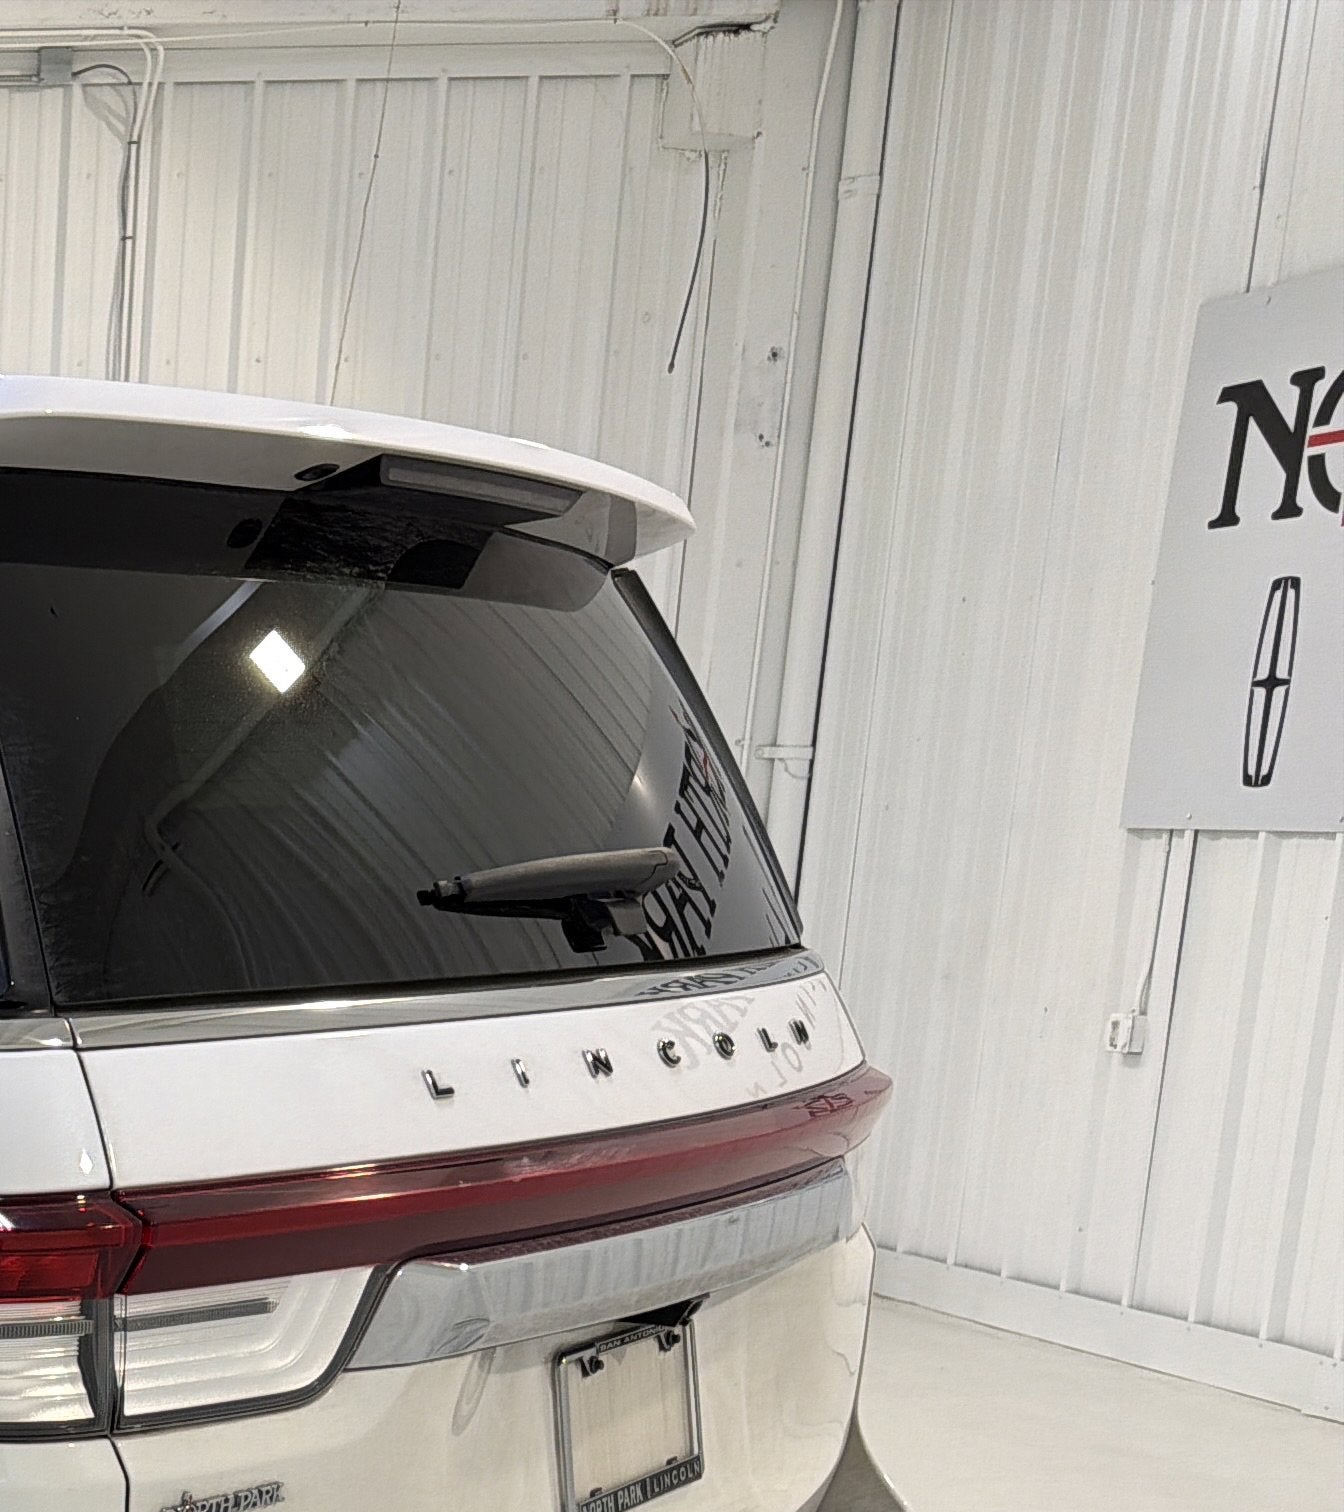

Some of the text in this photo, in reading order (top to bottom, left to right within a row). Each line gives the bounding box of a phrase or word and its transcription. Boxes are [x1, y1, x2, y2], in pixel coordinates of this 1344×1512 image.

[422, 1019, 810, 1100] LINCOLN
[238, 1483, 285, 1509] PARK
[618, 1483, 643, 1512] PARK
[653, 1460, 700, 1492] LINCOLN
